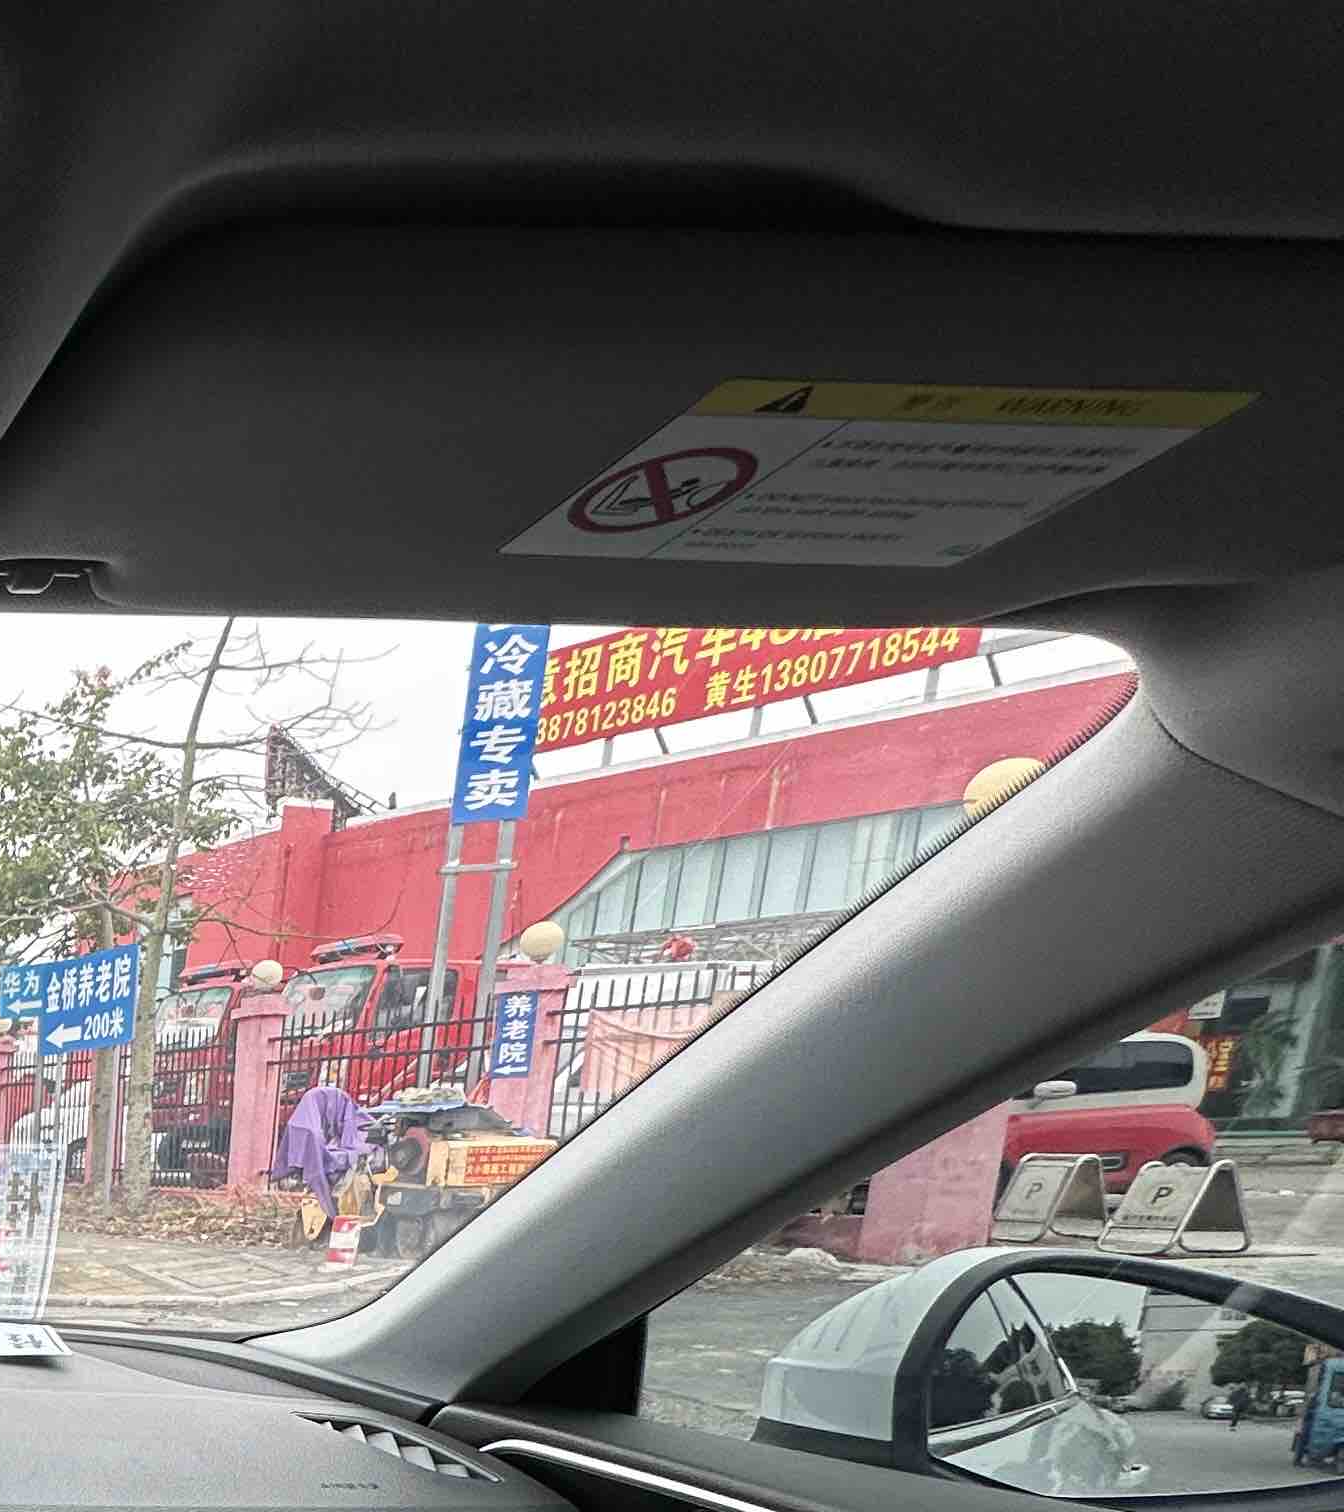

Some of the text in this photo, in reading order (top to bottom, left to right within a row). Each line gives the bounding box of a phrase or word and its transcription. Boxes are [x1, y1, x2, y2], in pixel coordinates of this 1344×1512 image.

[704, 627, 961, 711] 黄生13807718544
[463, 624, 539, 811] 冷藏专卖
[2, 968, 41, 999] 华为
[45, 952, 132, 1014] 金桥养老院
[83, 1005, 125, 1041] 200米
[498, 994, 533, 1065] 养老院
[1152, 1186, 1173, 1205] P
